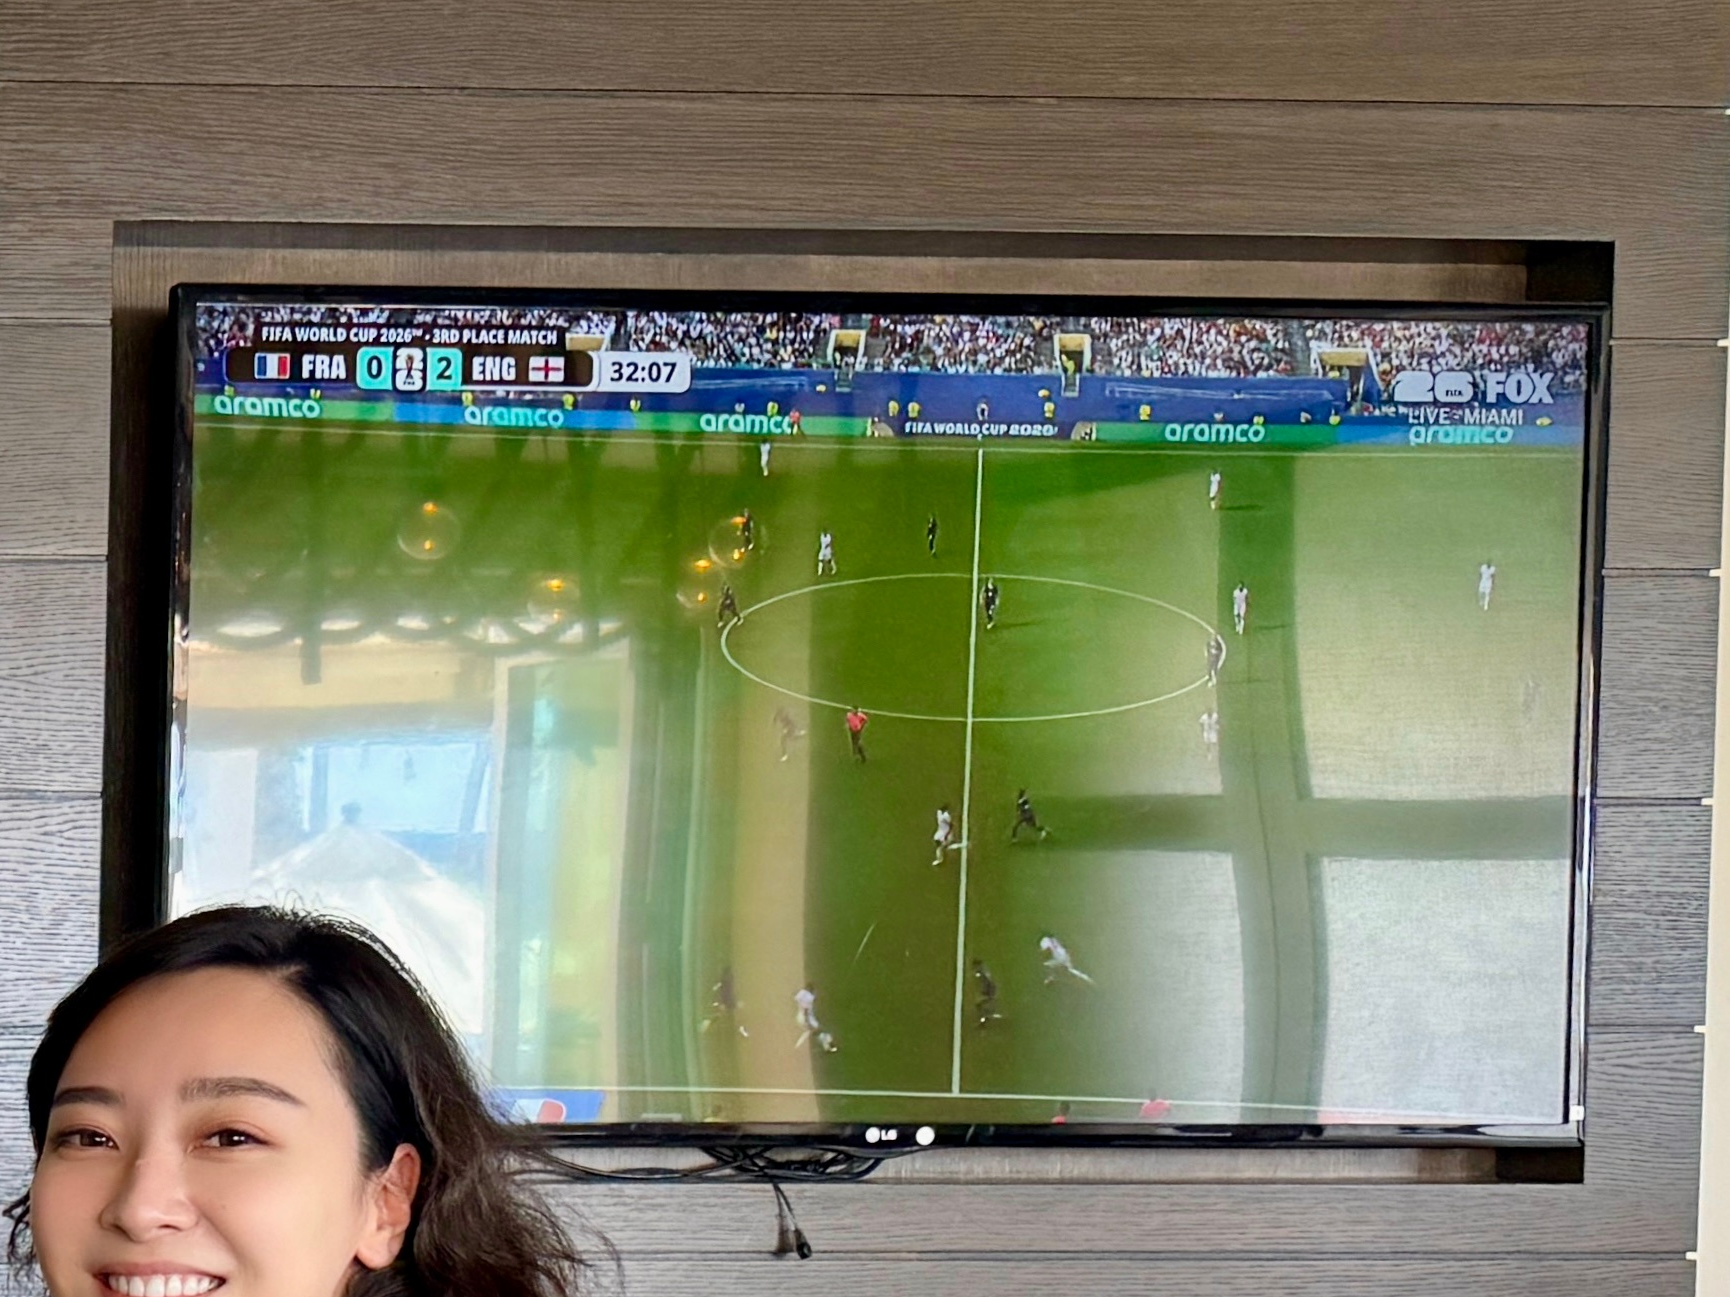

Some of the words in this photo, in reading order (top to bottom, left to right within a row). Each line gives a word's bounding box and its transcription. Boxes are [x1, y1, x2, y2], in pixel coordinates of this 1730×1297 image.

[262, 327, 292, 342] FIFA
[295, 327, 347, 343] WORLD
[349, 328, 377, 343] CUP
[433, 328, 459, 344] 3RD
[463, 329, 504, 344] PLACE
[507, 329, 557, 345] MATCH
[302, 354, 346, 379] FRA
[366, 355, 383, 379] 0
[436, 356, 453, 380] 2
[472, 356, 516, 381] ENG
[610, 361, 677, 383] 32:07
[1486, 371, 1554, 404] FOX
[214, 395, 320, 418] aramco
[464, 405, 564, 428] aramco
[1408, 407, 1449, 425] LIVE
[1464, 407, 1524, 426] MIAMI
[934, 422, 980, 435] WORLD
[982, 423, 1008, 435] CUP
[1165, 423, 1265, 442] aramco
[1409, 425, 1514, 445] aramco
